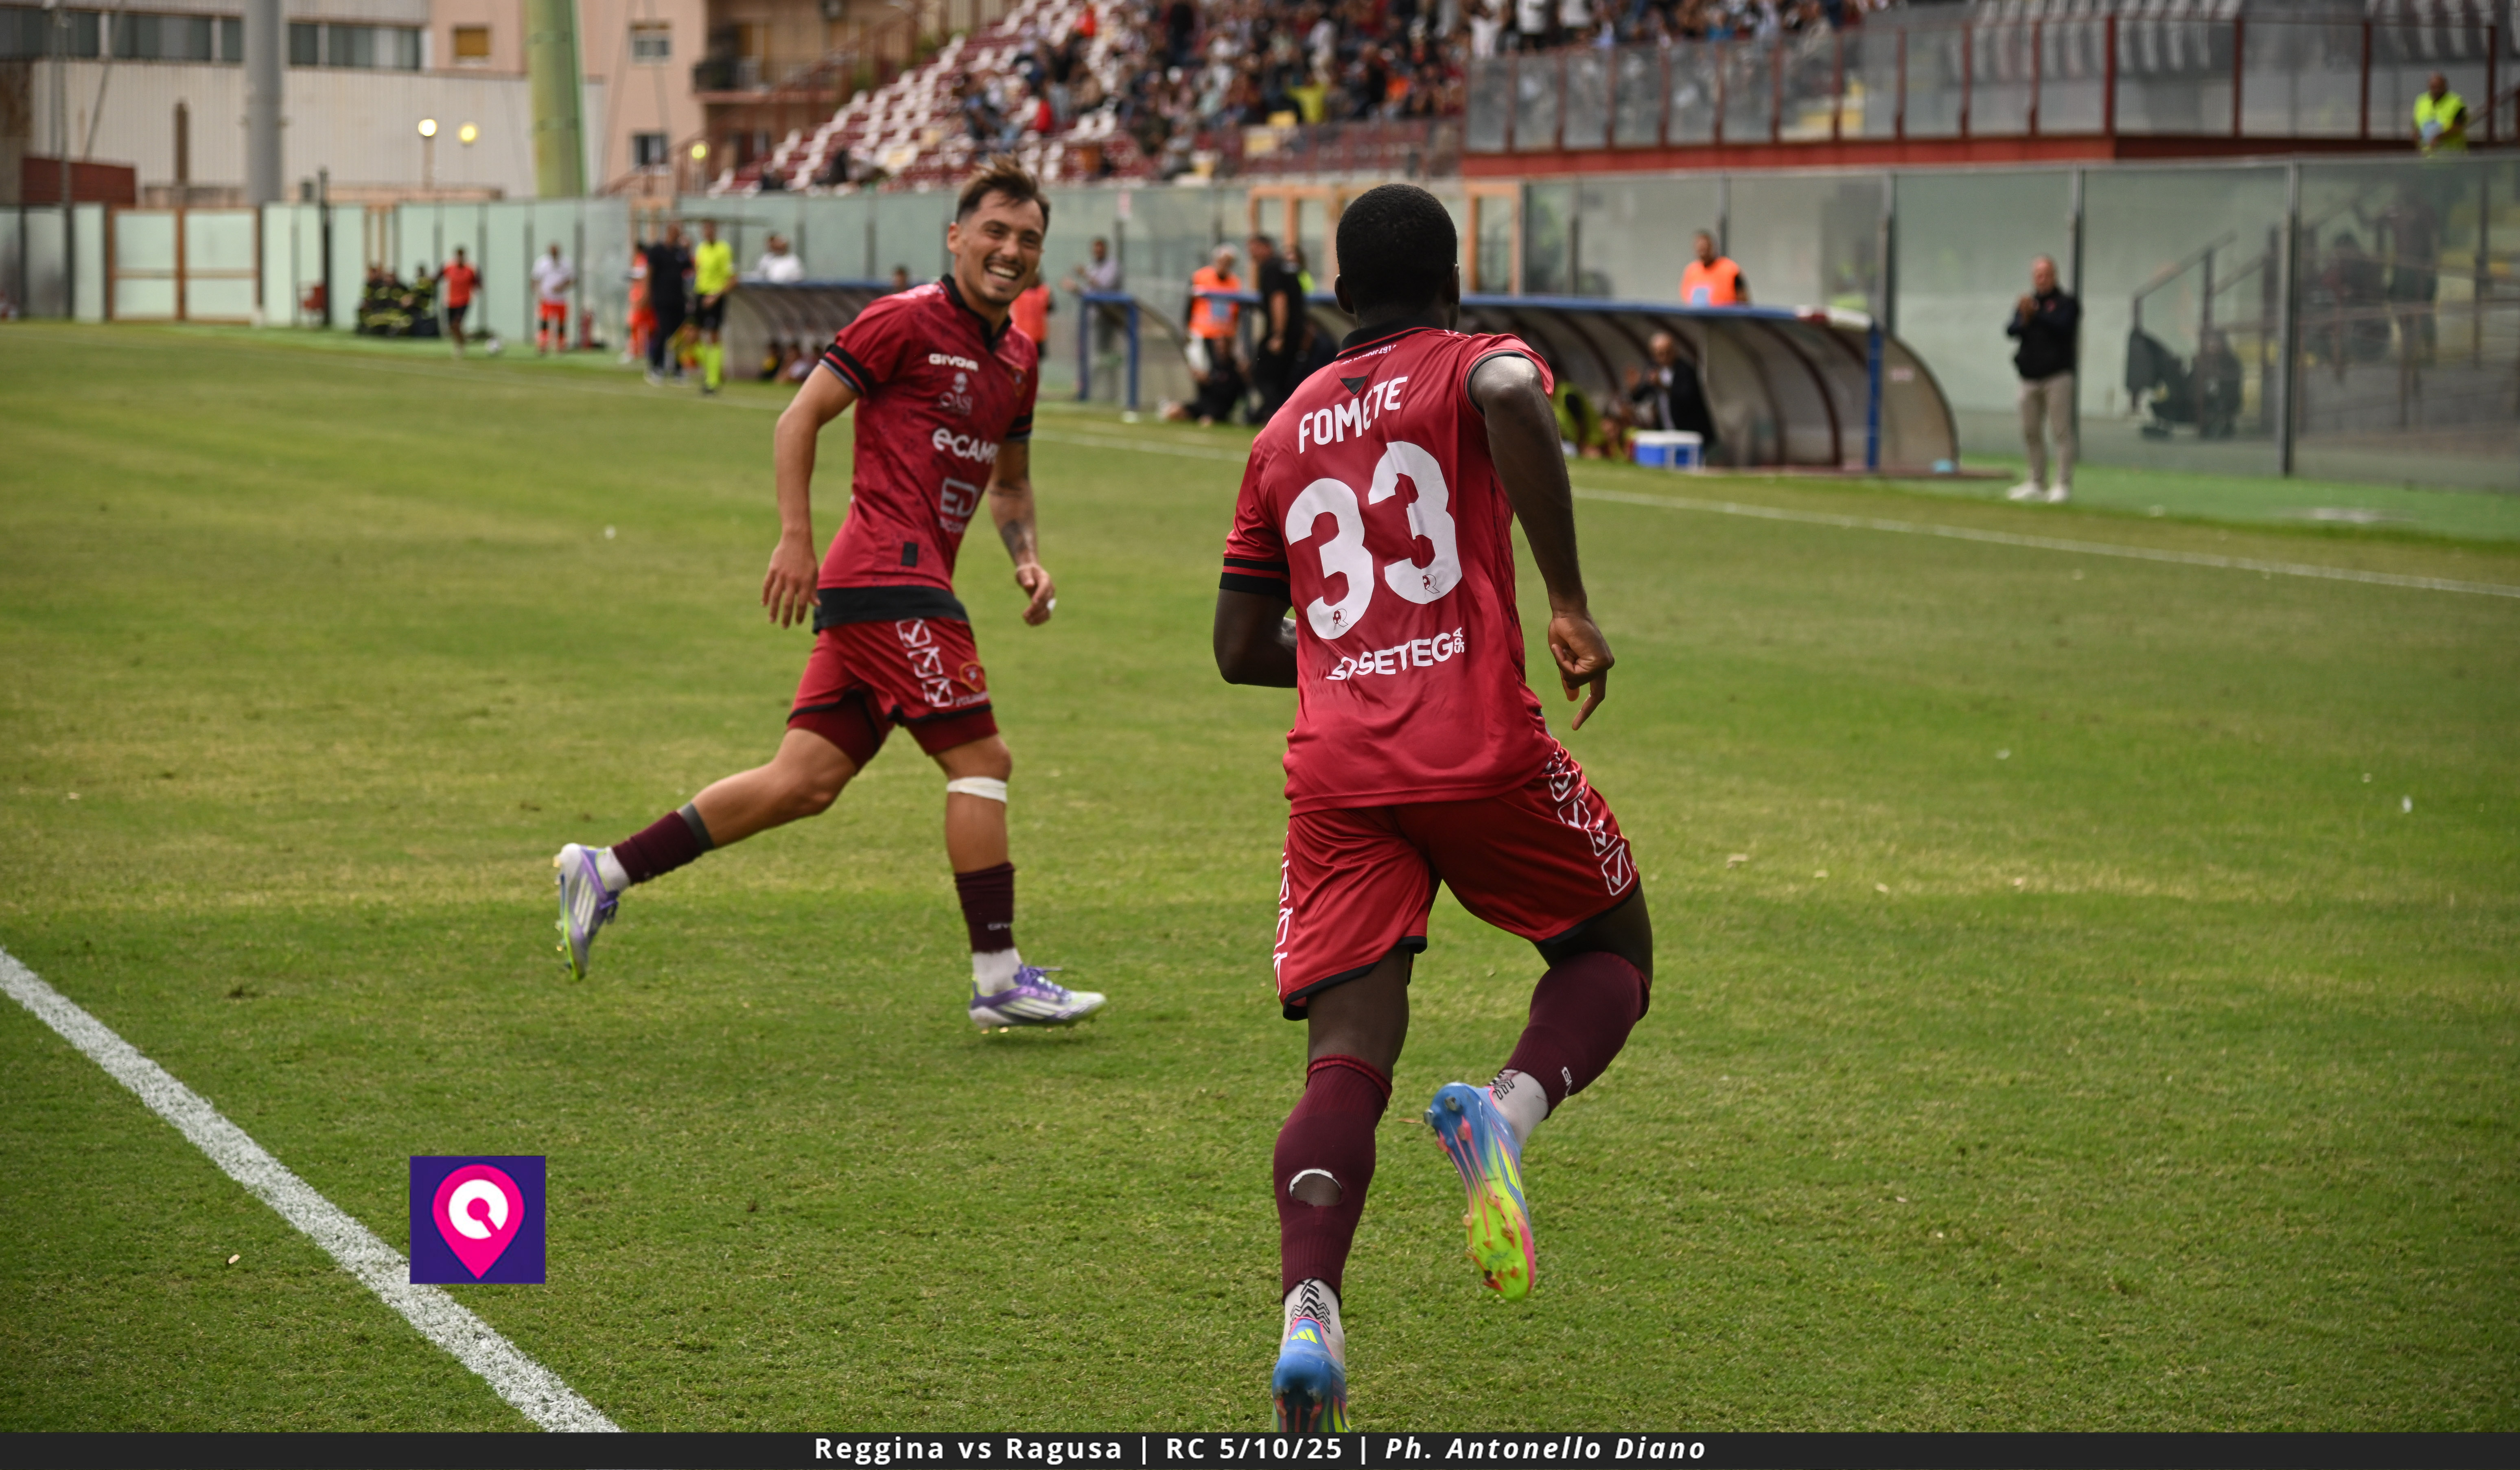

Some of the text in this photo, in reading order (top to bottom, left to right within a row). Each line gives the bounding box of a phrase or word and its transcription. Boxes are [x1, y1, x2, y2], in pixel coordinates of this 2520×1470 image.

[1299, 376, 1409, 454] FOMETE
[1285, 441, 1463, 640] 33
[1452, 627, 1465, 654] SPA
